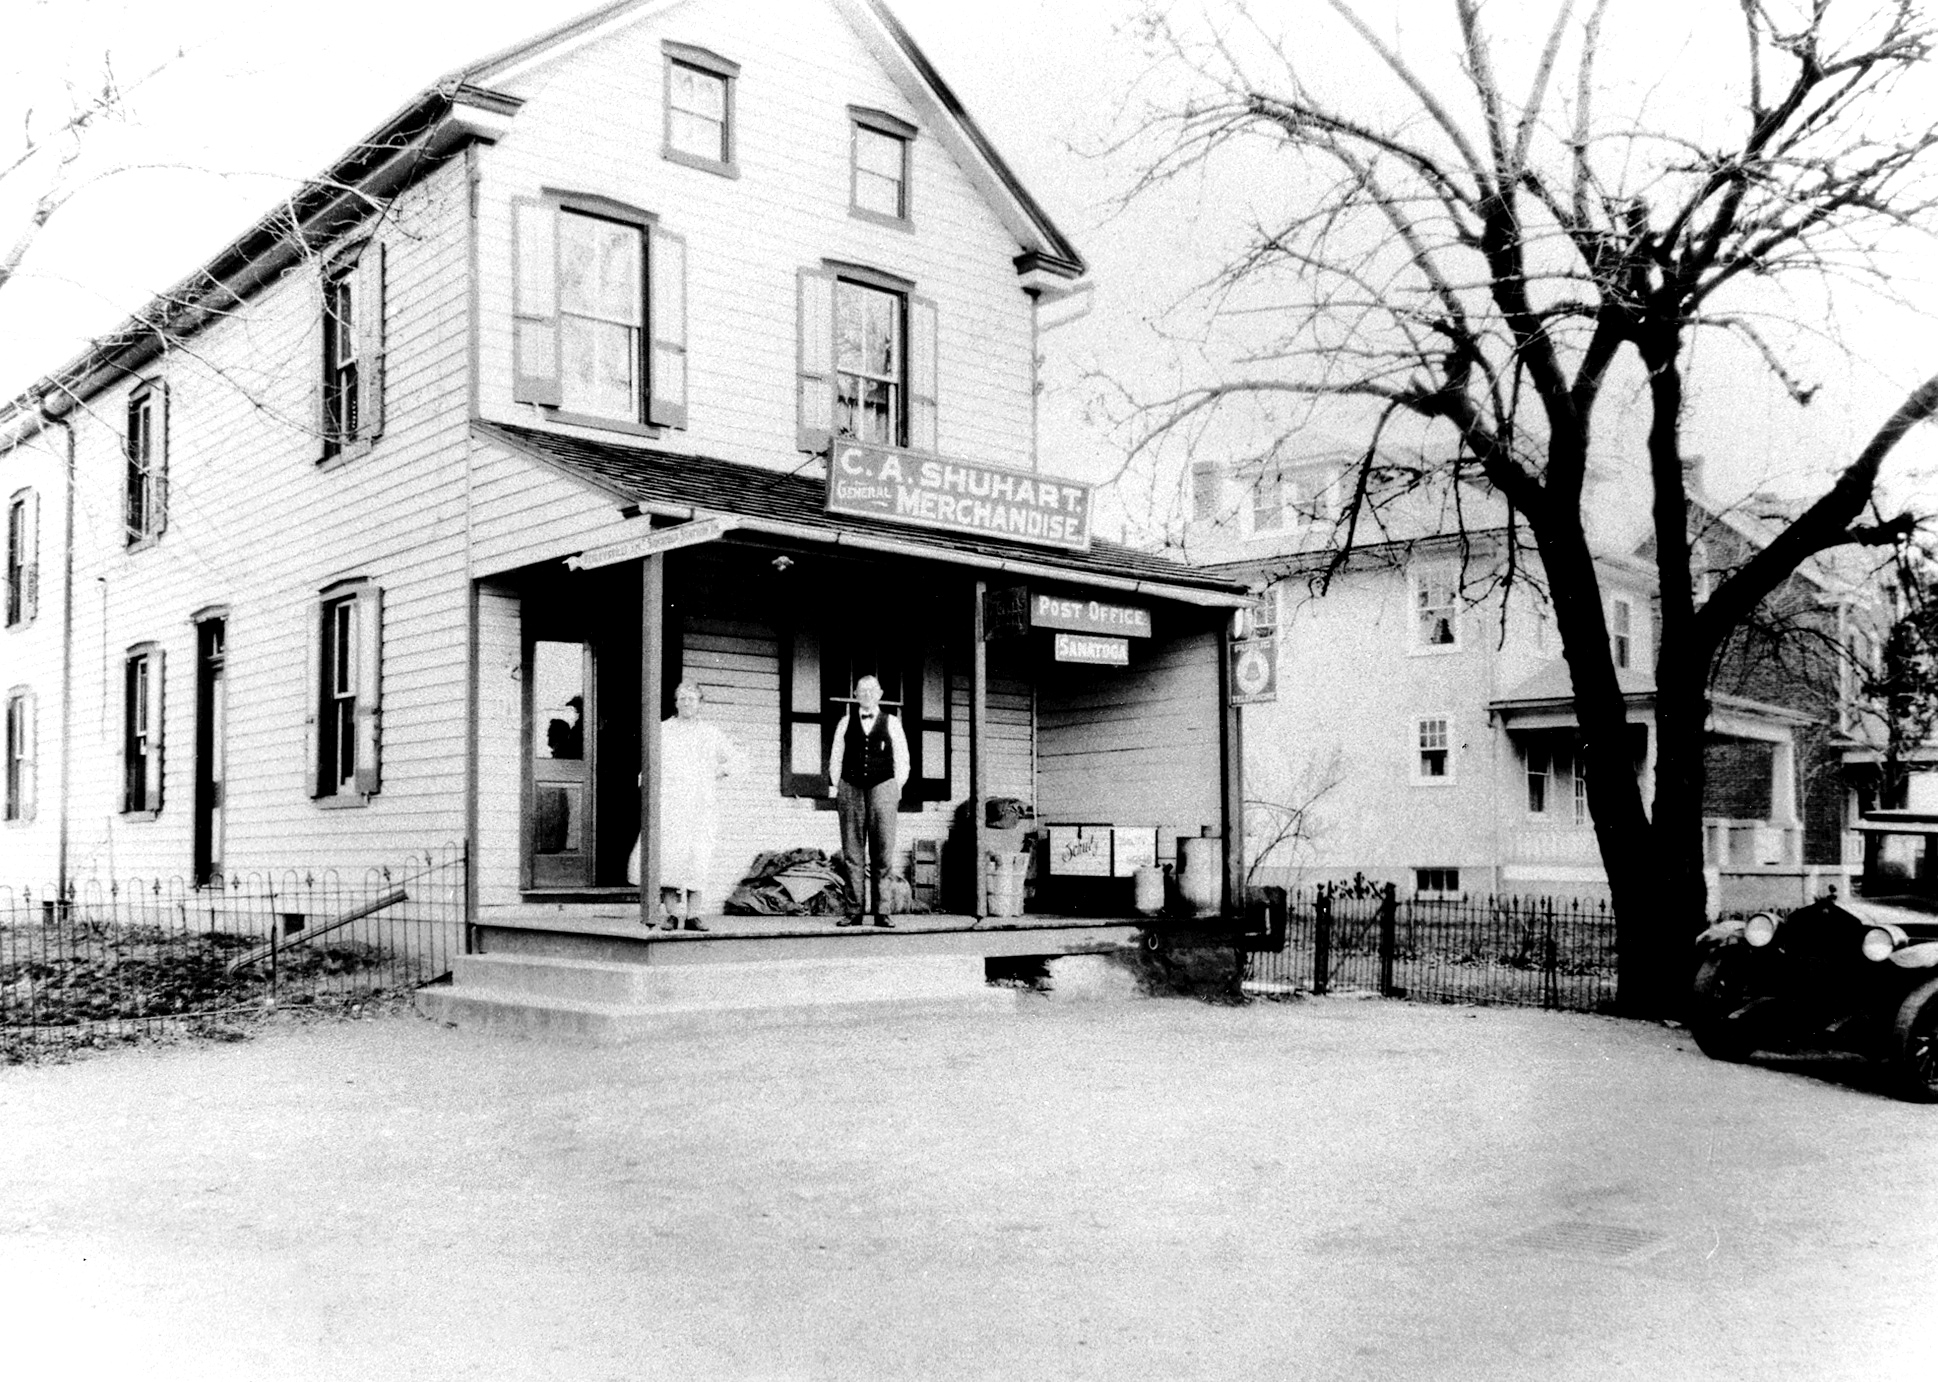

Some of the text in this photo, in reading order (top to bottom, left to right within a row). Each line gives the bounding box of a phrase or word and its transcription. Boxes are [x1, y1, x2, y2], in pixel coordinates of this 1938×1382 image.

[837, 479, 893, 499] GENERAL
[841, 447, 1082, 514] C. A. SHUHART.
[1038, 594, 1084, 619] POST
